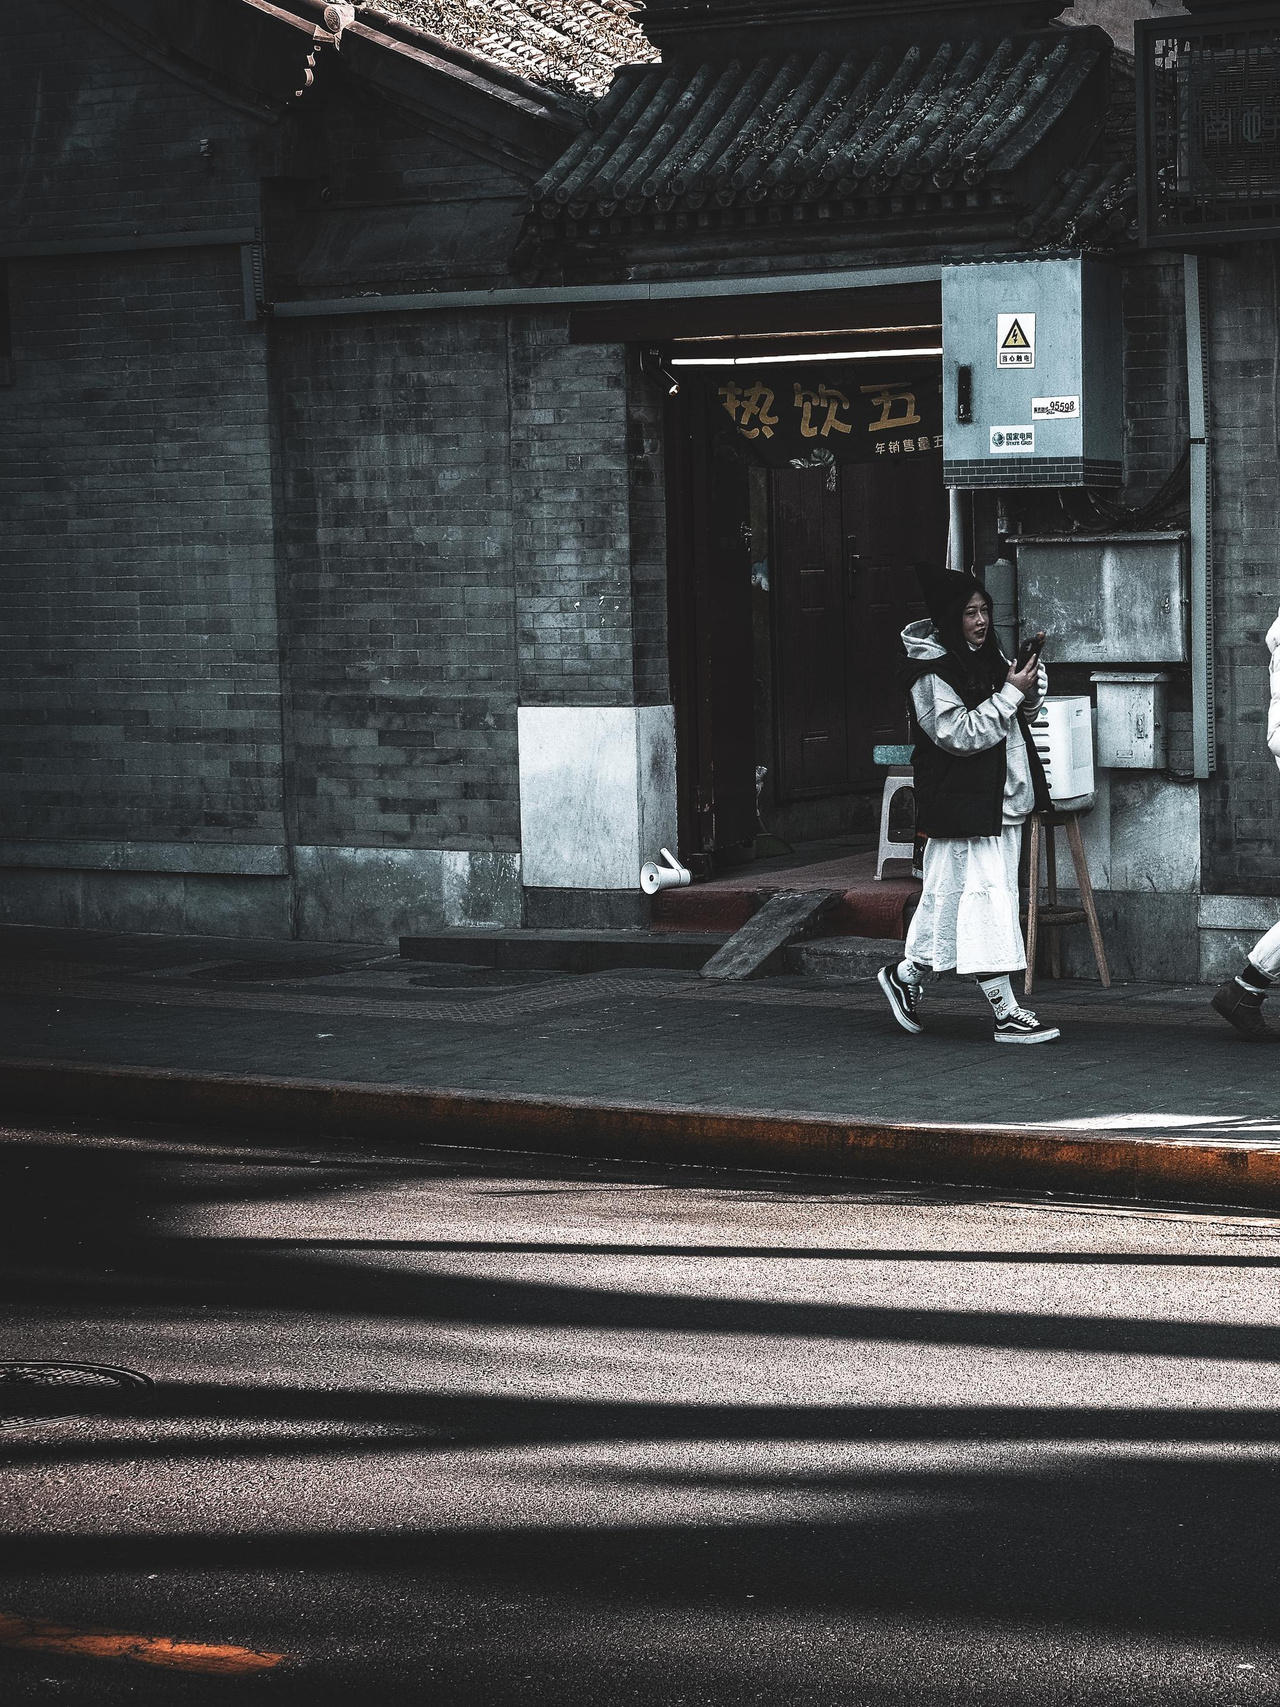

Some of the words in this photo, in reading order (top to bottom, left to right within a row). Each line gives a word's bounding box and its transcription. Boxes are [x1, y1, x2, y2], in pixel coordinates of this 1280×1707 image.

[717, 380, 943, 440] 热饮五
[1049, 400, 1075, 412] 95598
[1006, 432, 1033, 441] 国家电网
